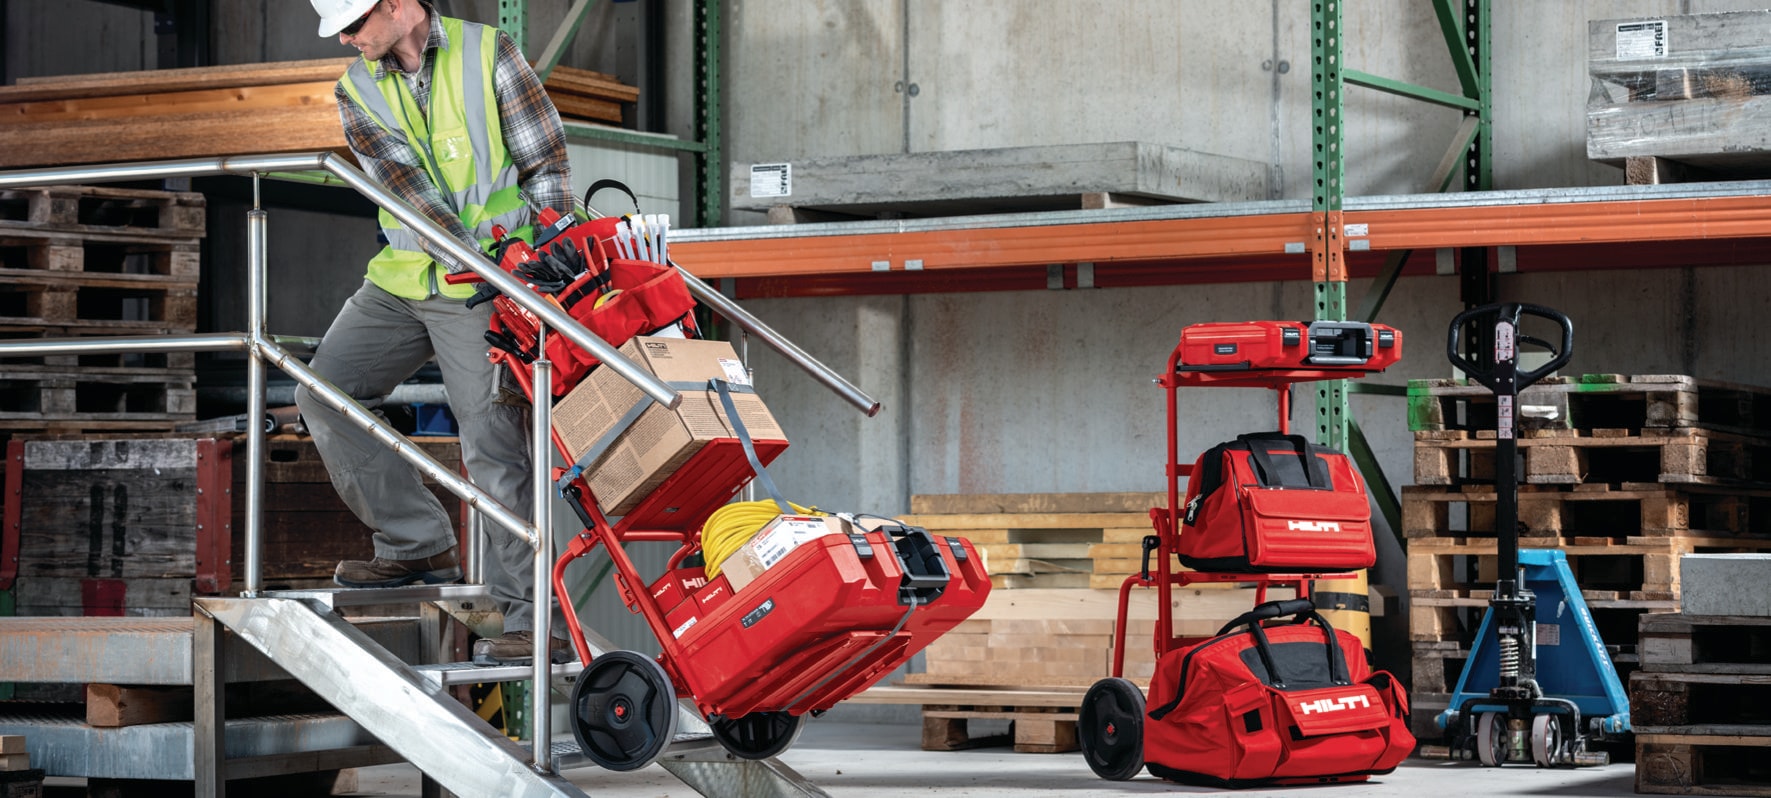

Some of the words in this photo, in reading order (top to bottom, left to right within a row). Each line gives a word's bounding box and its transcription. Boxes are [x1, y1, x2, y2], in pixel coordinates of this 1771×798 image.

[1655, 22, 1663, 47] FREI
[1287, 520, 1340, 532] HILTI
[653, 582, 672, 599] HILTI
[682, 577, 708, 589] HIL
[702, 586, 723, 604] HILTI
[1300, 695, 1370, 715] HILTI
